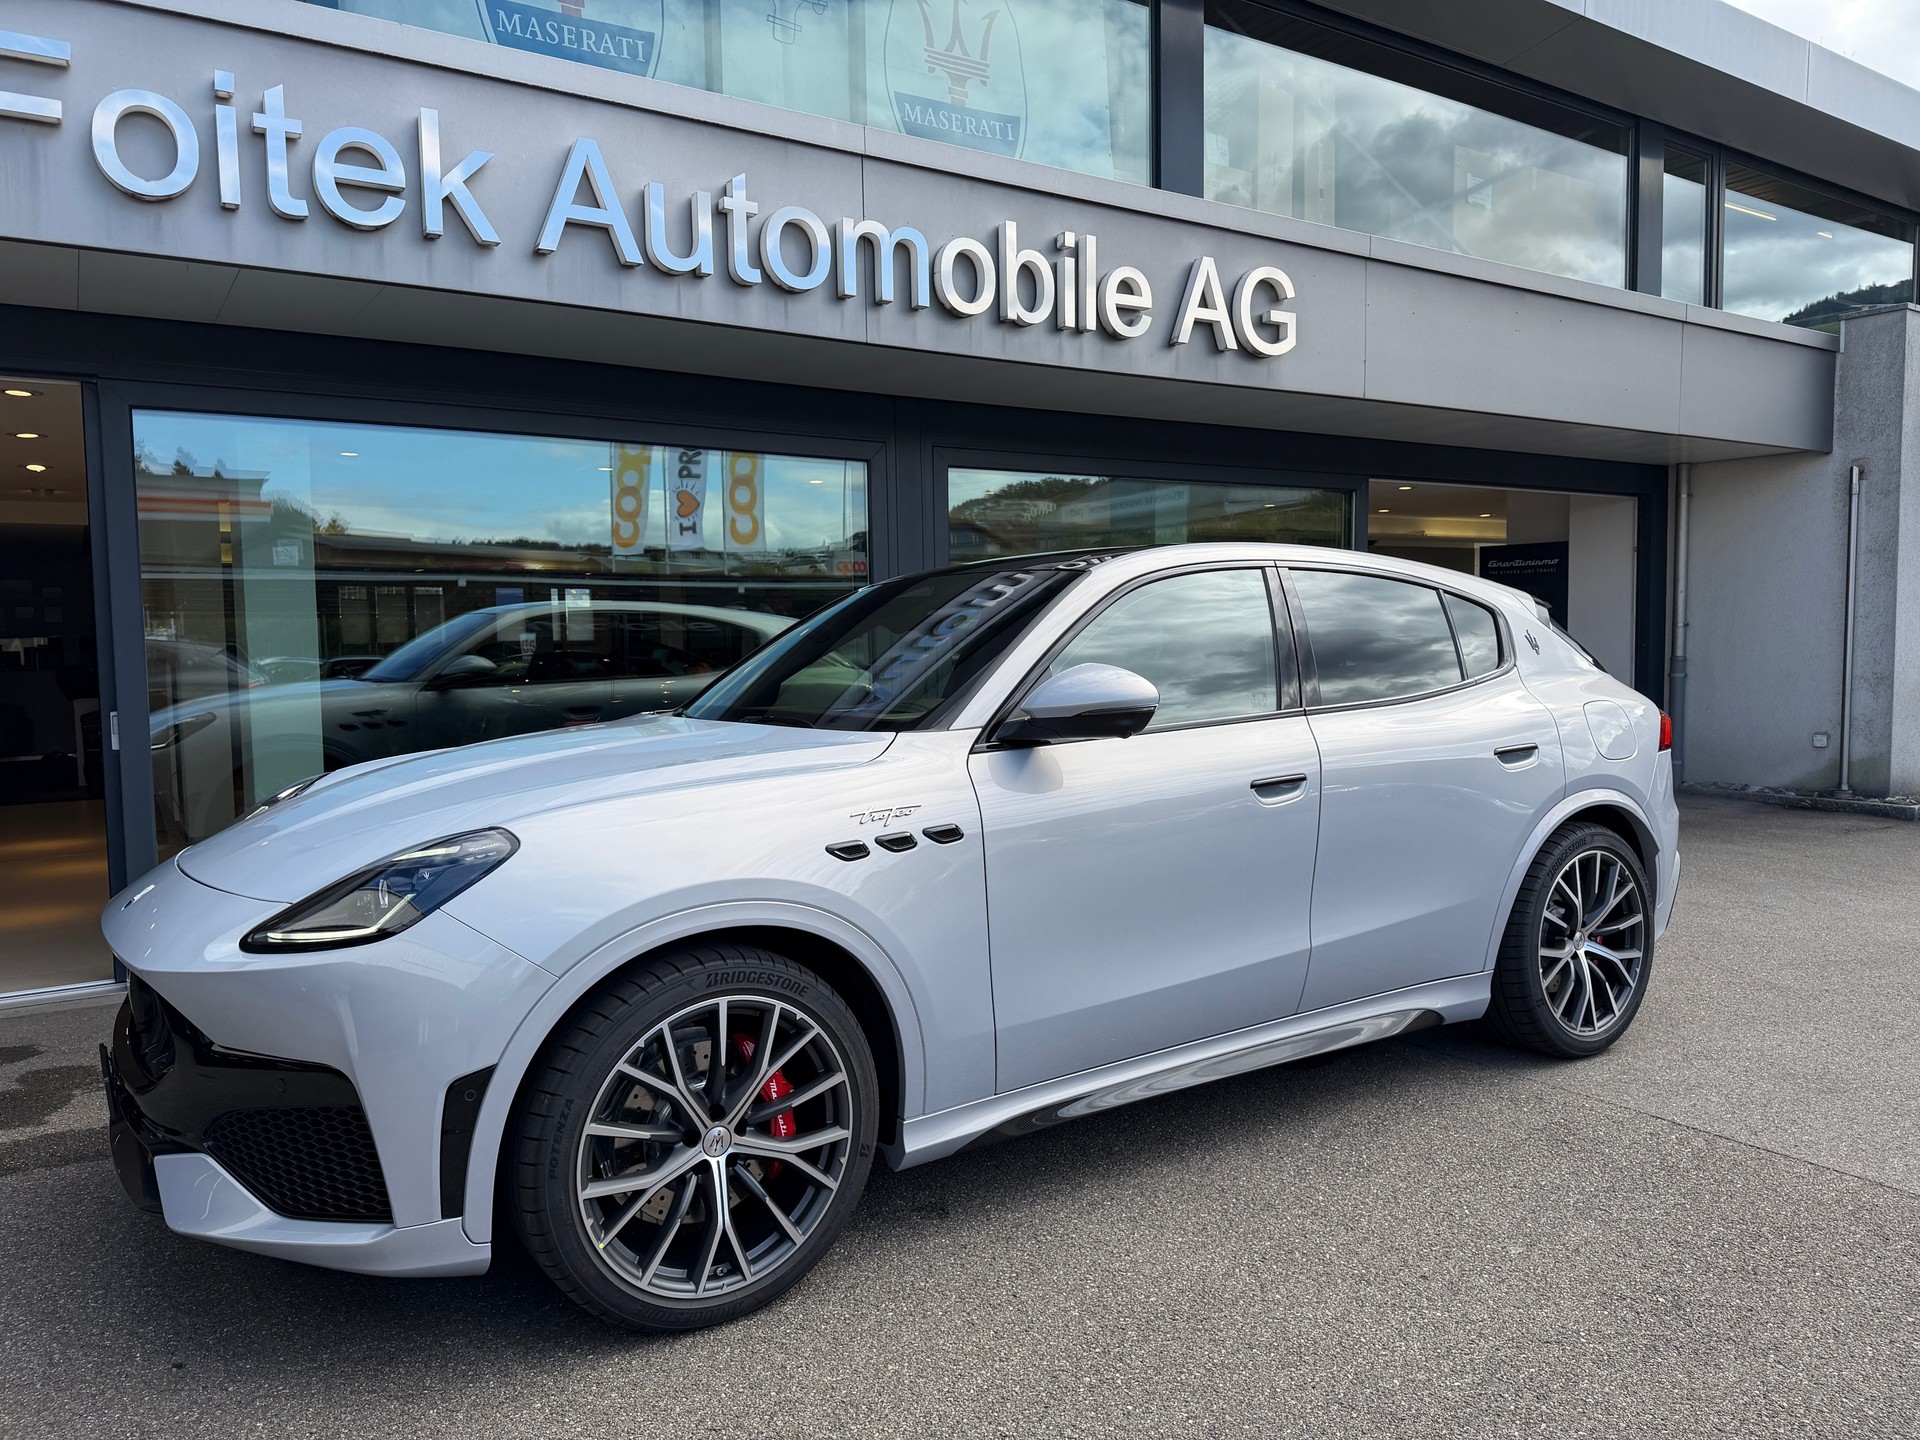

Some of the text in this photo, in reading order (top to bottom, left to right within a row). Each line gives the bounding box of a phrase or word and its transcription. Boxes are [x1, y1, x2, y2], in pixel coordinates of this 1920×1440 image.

[496, 8, 646, 63] MASERATI
[903, 102, 1015, 141] MASERATI
[534, 136, 1153, 341] Automobile
[1169, 256, 1297, 359] AG
[1487, 558, 1560, 568] GranTurismo
[1547, 836, 1589, 880] BRIDGESTONE
[705, 970, 809, 998] BRIDGESTONE
[549, 1098, 574, 1180] POTENZA
